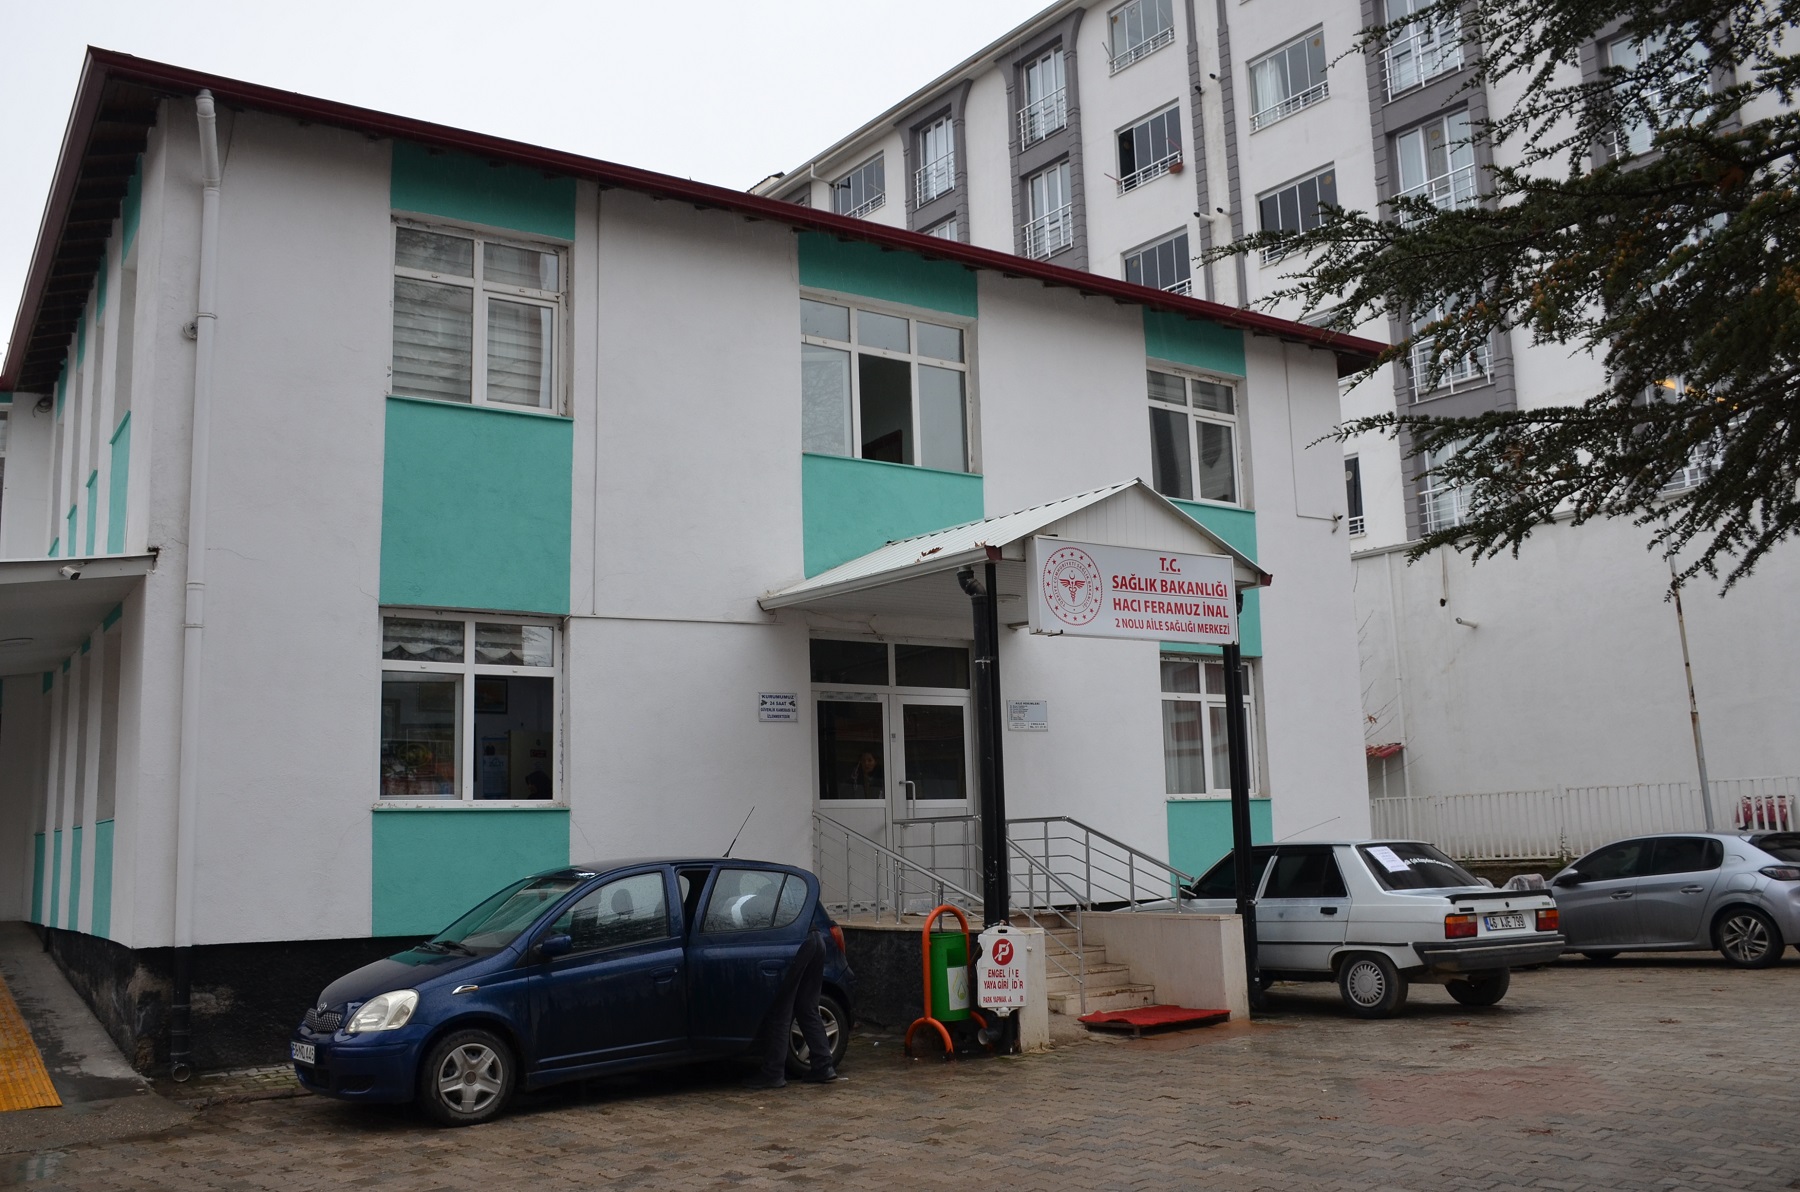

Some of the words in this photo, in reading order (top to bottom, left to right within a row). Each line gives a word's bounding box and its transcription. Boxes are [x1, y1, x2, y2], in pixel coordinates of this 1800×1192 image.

[1159, 557, 1181, 573] T.C.
[1112, 573, 1158, 593] SAĞLIK
[1160, 579, 1228, 598] BAKANLIĞI
[1113, 597, 1142, 613] HACI
[1144, 600, 1201, 617] FERAMUZ
[1202, 601, 1229, 619] İNAL
[1115, 618, 1121, 628] 2
[1122, 618, 1145, 630] NOLU
[1146, 618, 1164, 631] AİLE
[1165, 619, 1196, 633] SAĞLIĞI
[1197, 622, 1230, 635] MERKEZİ
[988, 967, 1011, 978] ENGELİ
[984, 980, 997, 990] YAYA
